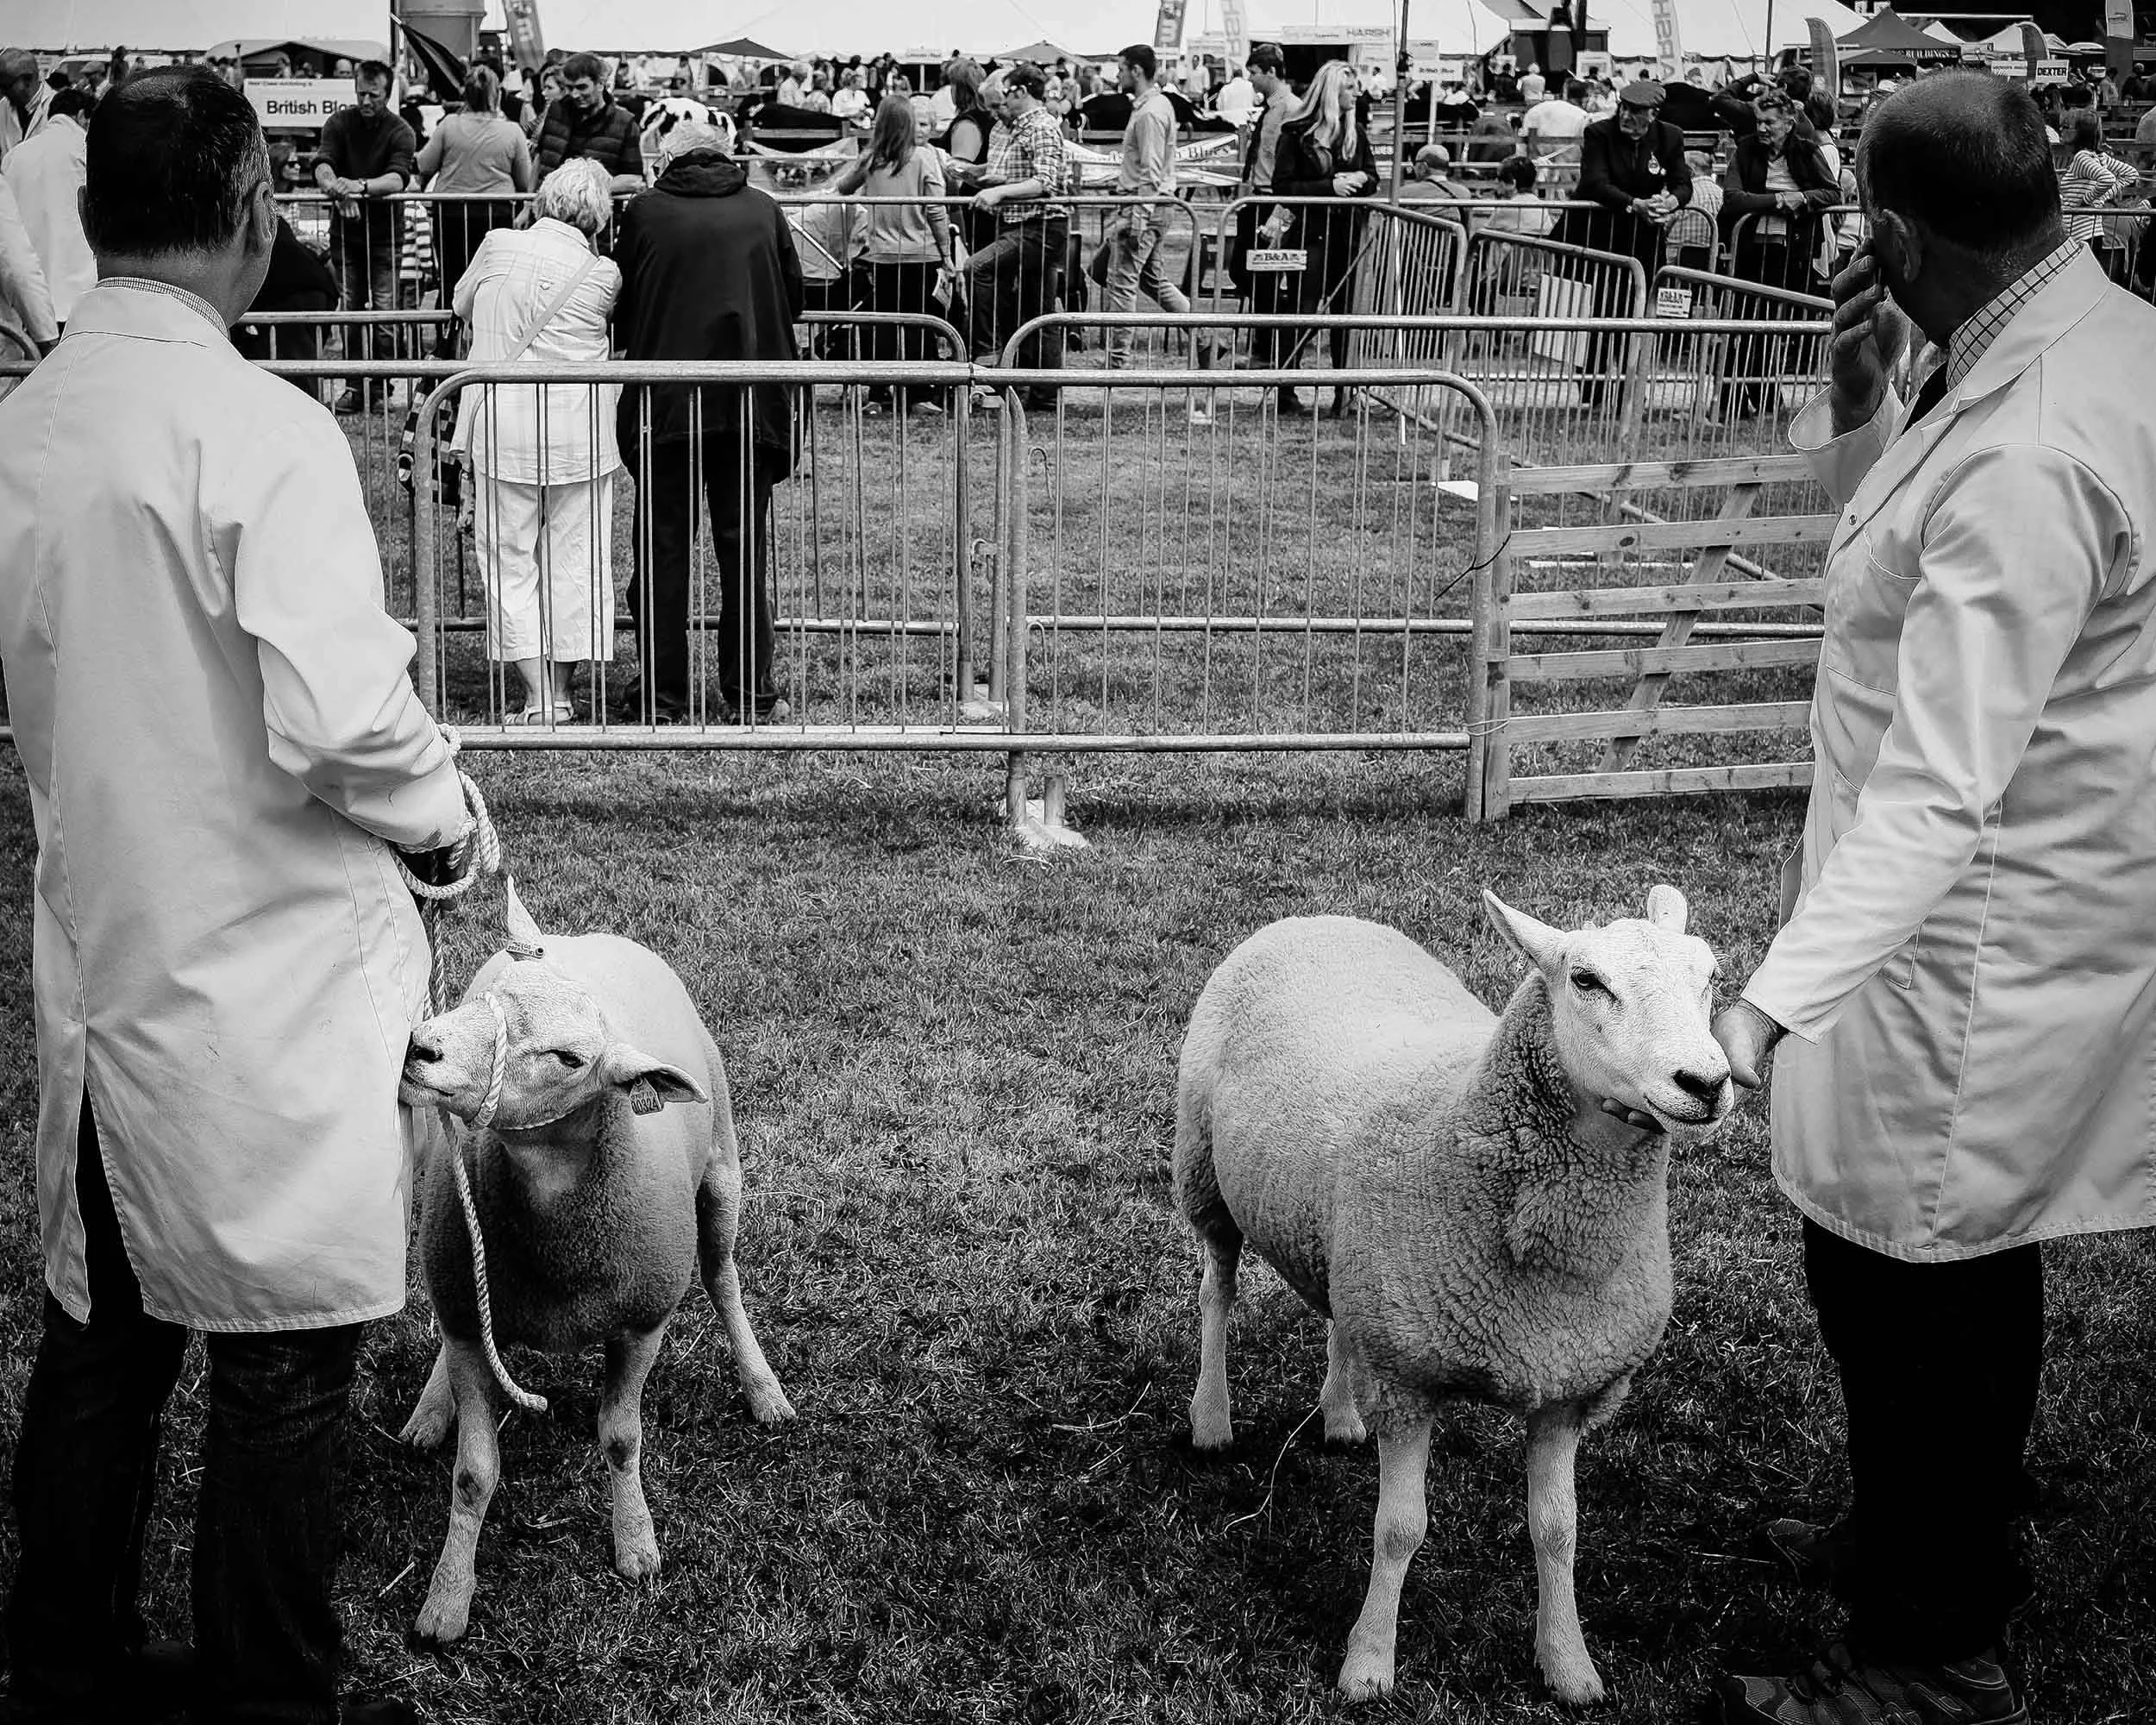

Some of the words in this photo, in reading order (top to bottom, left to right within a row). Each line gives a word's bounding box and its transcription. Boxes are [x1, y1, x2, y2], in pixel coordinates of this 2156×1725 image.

[2037, 67, 2067, 77] DEXTER
[266, 99, 317, 115] British
[323, 99, 357, 115] Blo
